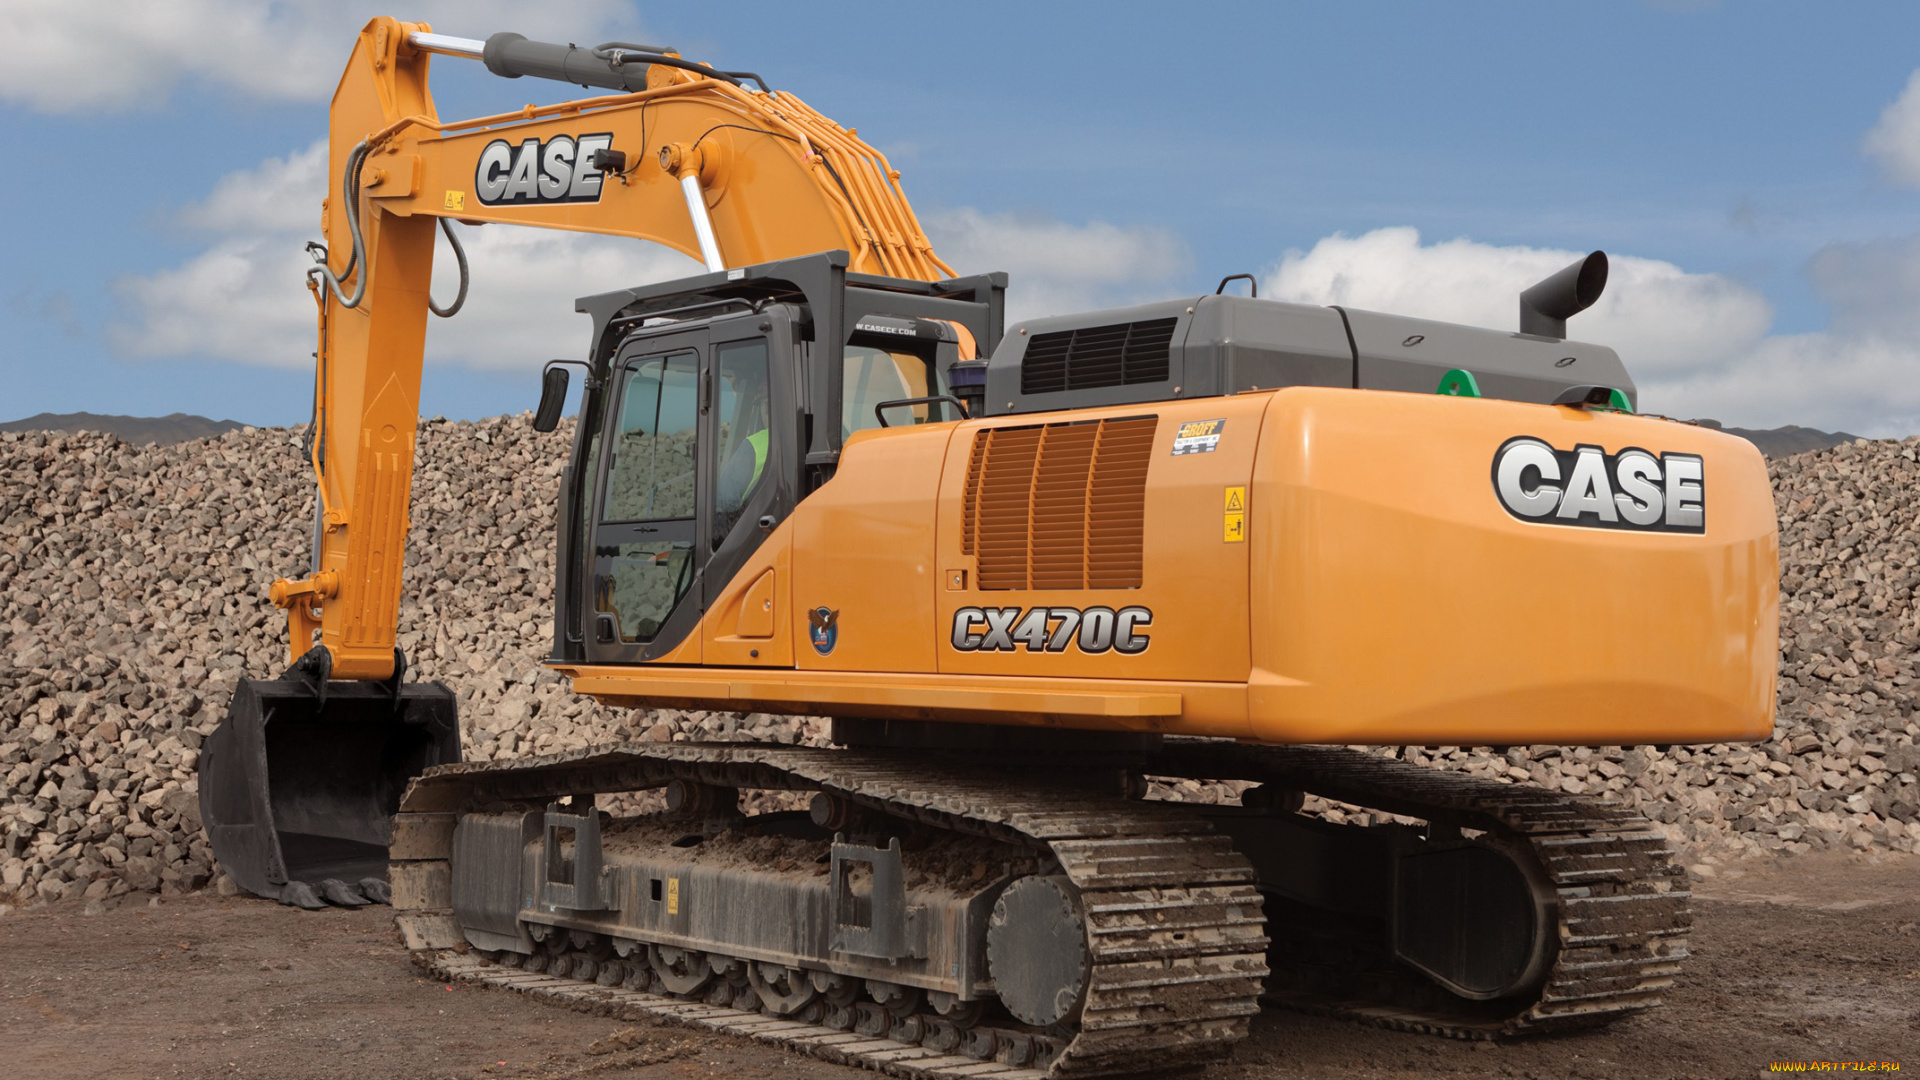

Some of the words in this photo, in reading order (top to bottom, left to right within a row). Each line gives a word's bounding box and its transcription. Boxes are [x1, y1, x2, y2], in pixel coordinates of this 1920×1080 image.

[476, 133, 613, 203] CASE
[855, 323, 917, 336] W.CASECE.COM
[1181, 421, 1219, 438] GROFF
[1494, 437, 1705, 530] CASE
[951, 606, 1153, 654] CX470C
